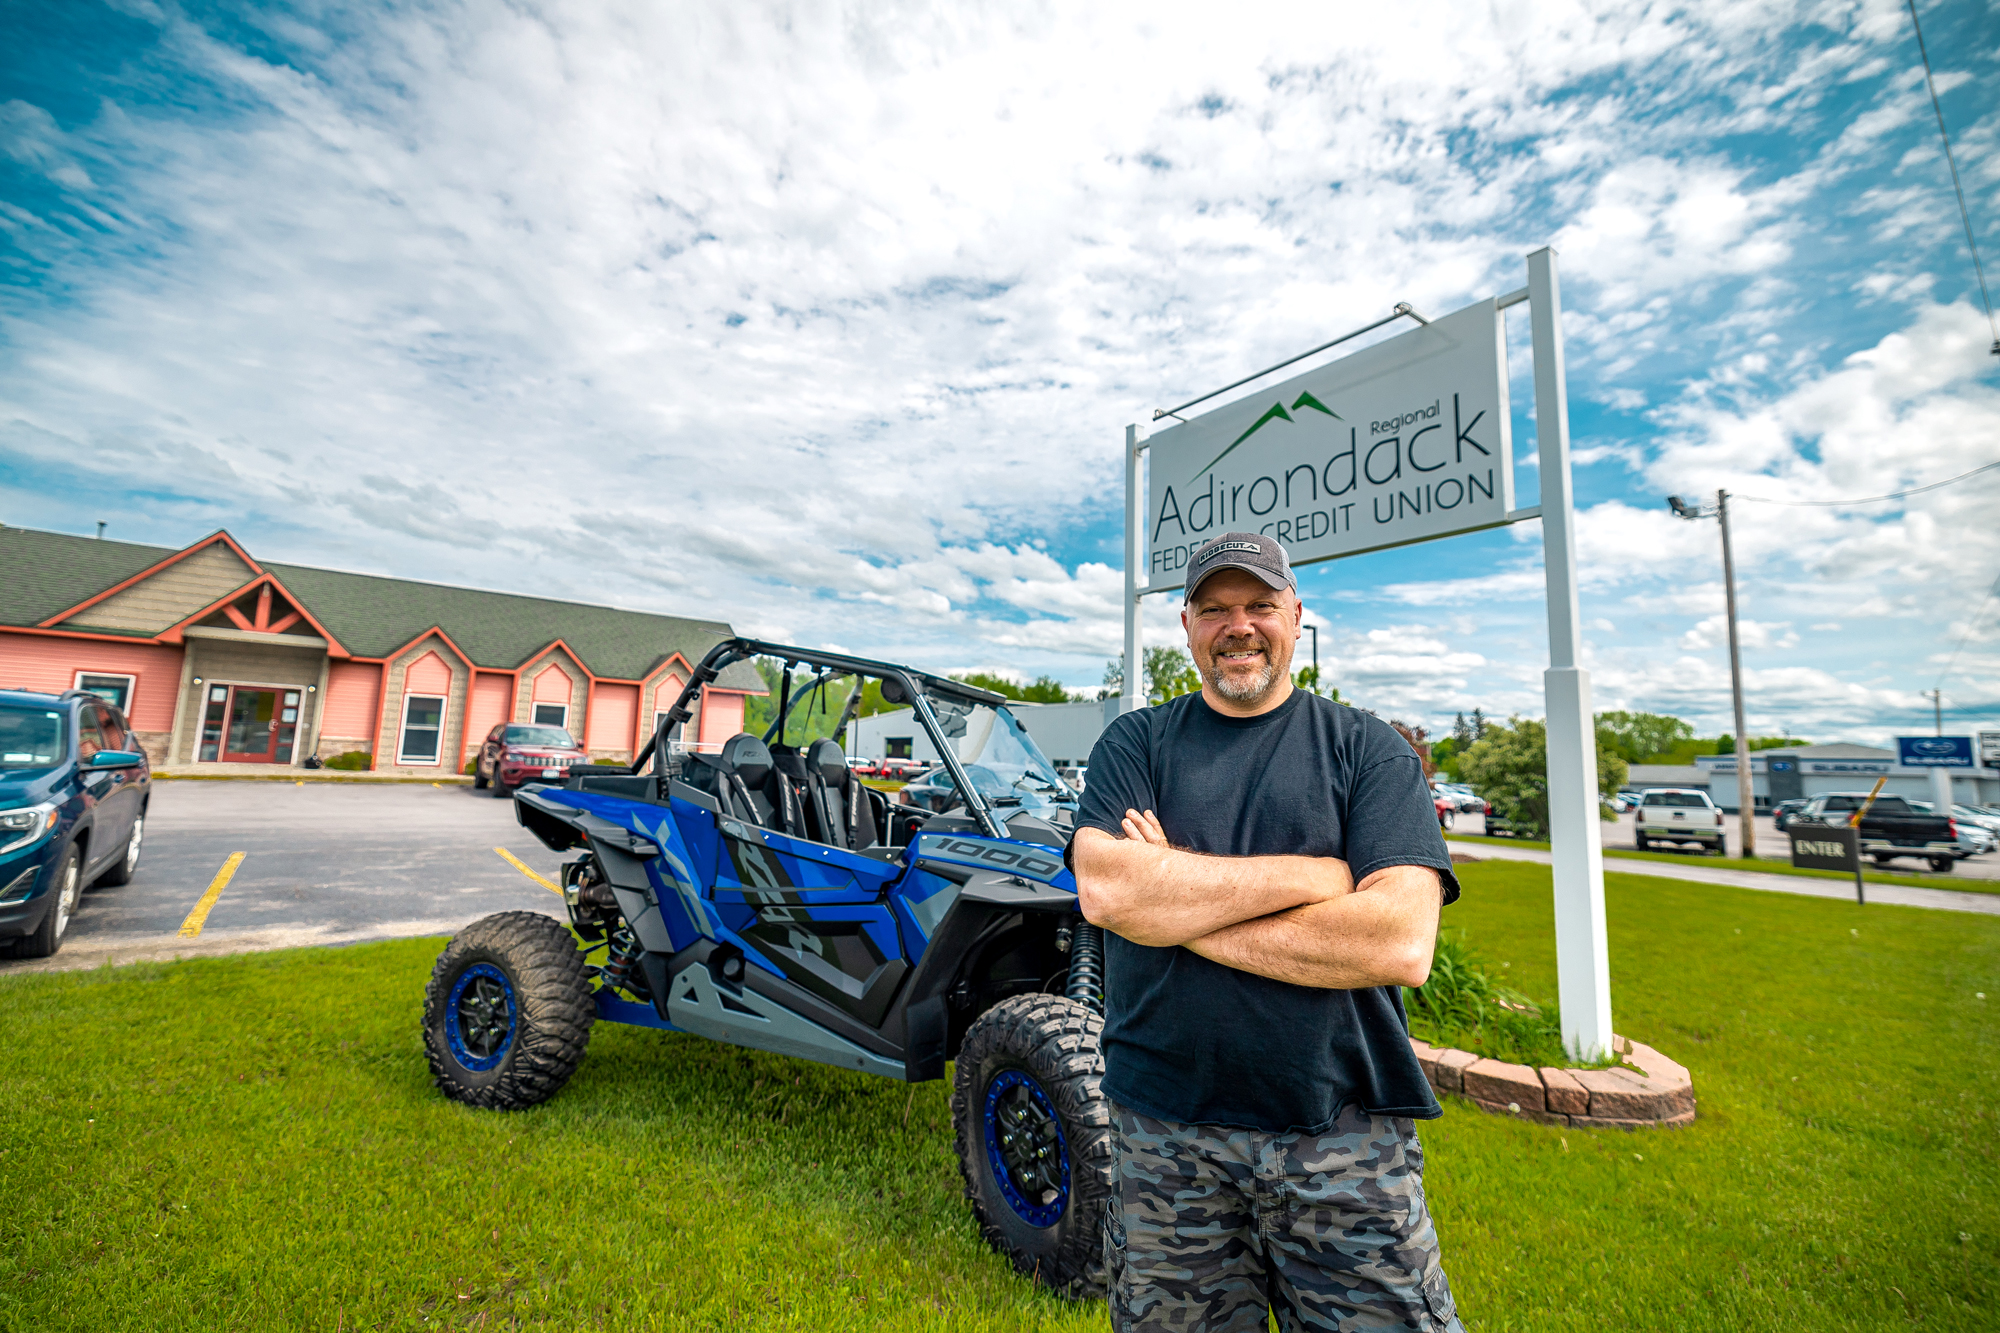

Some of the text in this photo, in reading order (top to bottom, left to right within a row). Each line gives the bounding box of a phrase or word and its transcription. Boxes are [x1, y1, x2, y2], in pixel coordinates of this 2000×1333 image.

[1370, 399, 1440, 436] Regional
[1153, 392, 1492, 543] Adirondack
[1373, 468, 1494, 524] UNION
[935, 837, 1060, 876] 1000
[1794, 839, 1846, 858] ENTER
